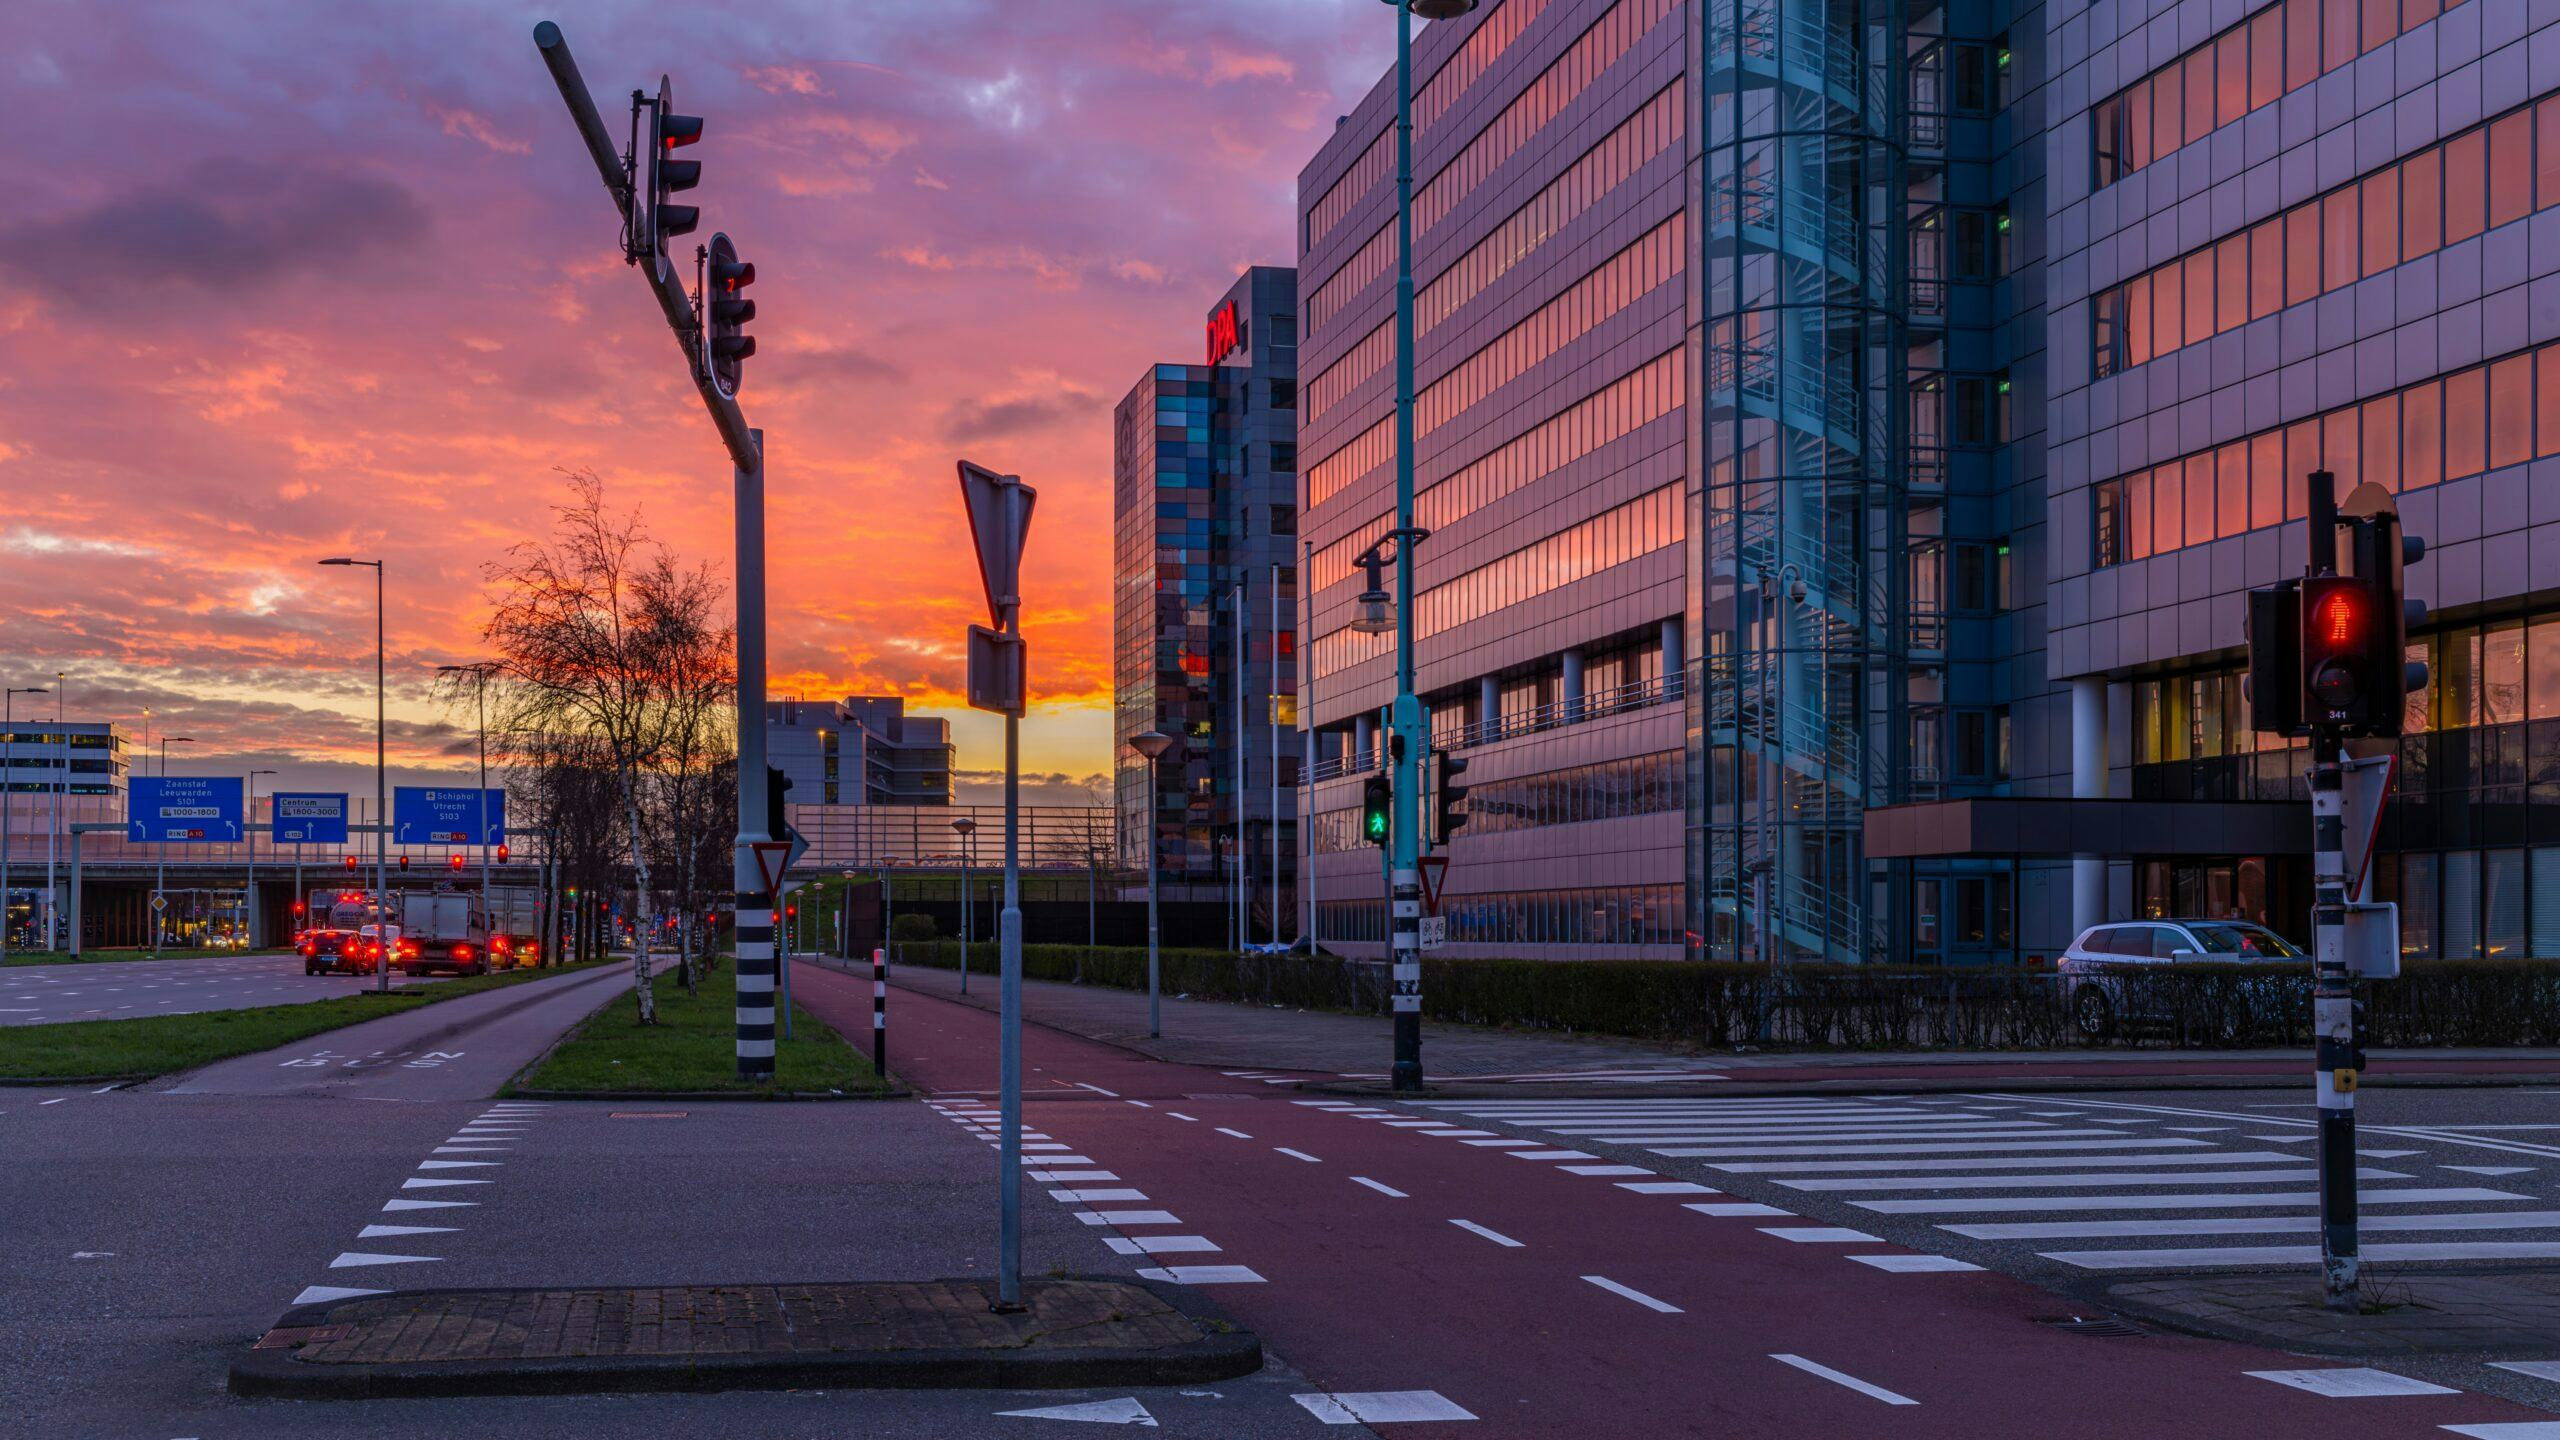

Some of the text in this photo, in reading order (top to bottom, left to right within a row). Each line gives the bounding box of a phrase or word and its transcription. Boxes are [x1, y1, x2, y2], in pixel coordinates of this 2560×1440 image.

[1206, 299, 1238, 367] DPA
[2329, 710, 2346, 719] 341
[166, 780, 206, 788] Zaanstad
